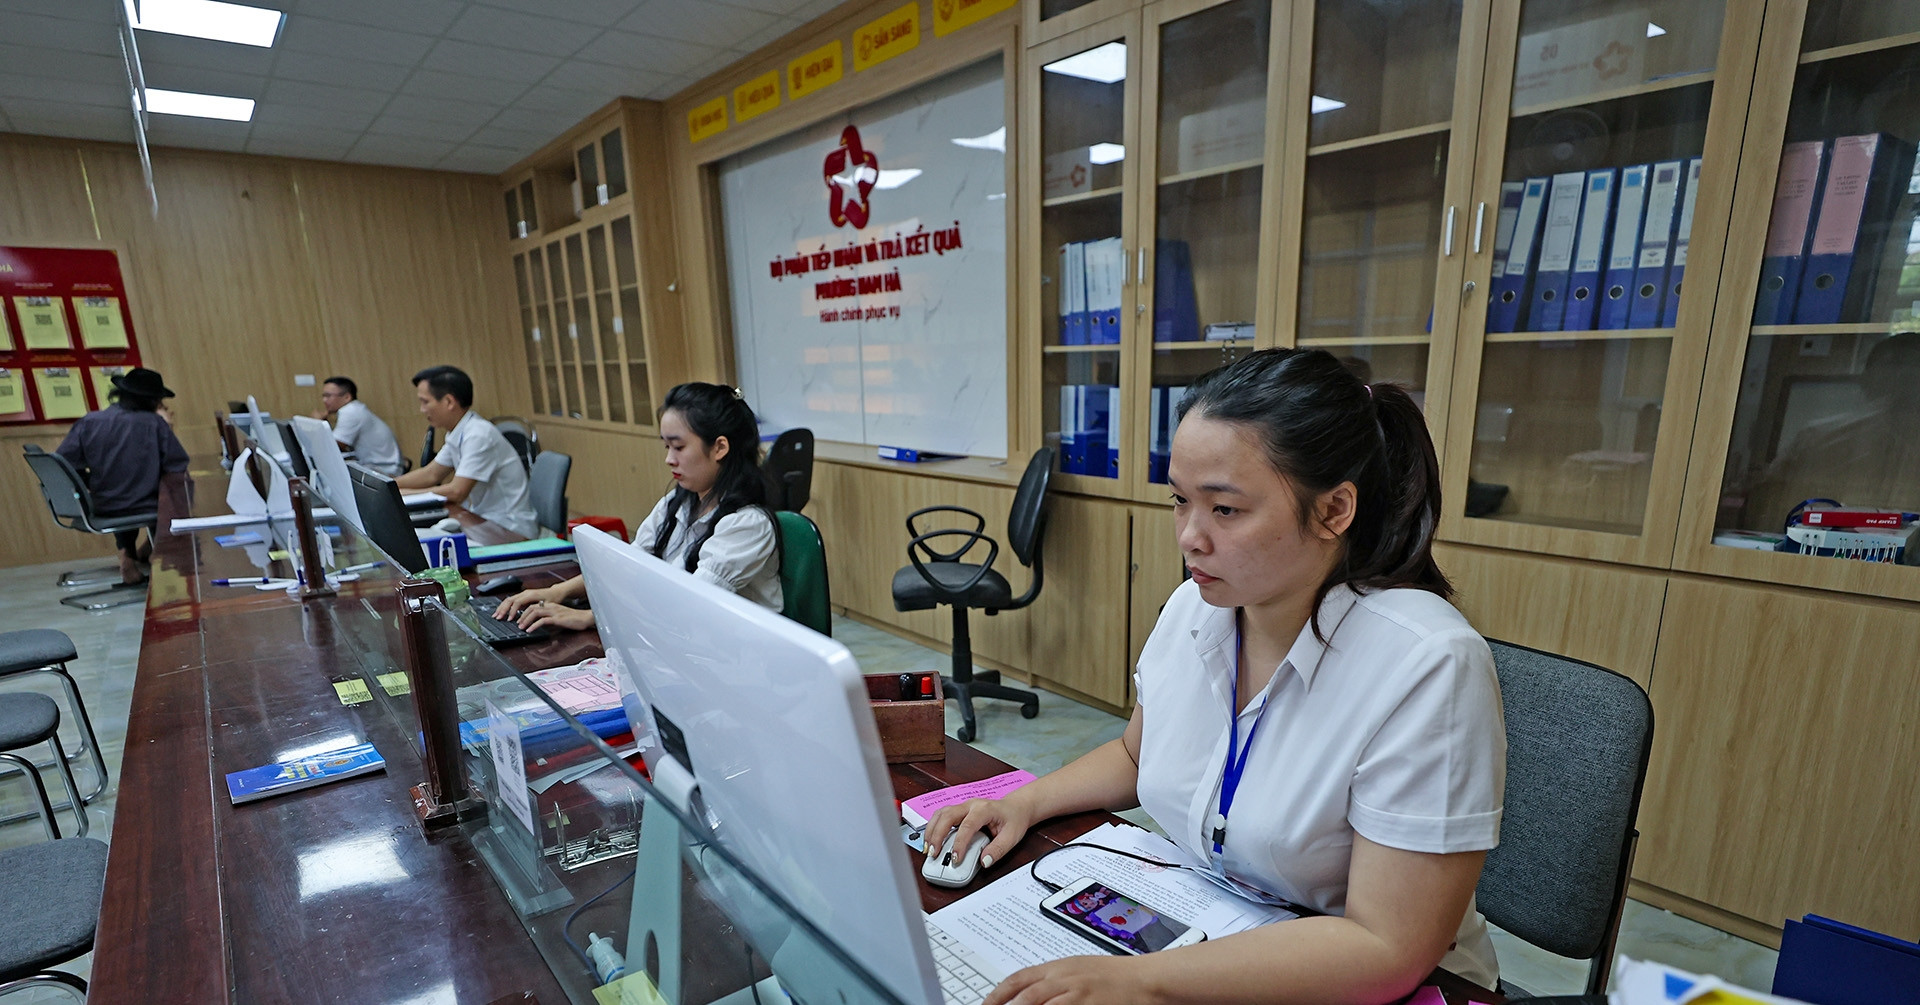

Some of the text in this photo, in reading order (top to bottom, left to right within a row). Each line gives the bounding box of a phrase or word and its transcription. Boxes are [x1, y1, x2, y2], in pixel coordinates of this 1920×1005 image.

[812, 244, 832, 271] TIẾP
[880, 232, 903, 260] TRẢ
[905, 224, 931, 256] KẾT
[933, 220, 963, 256] QUẢ
[858, 275, 882, 295] NAM
[884, 267, 902, 292] HÀ
[841, 305, 863, 321] chính
[865, 306, 887, 323] phục
[889, 305, 901, 320] vụ
